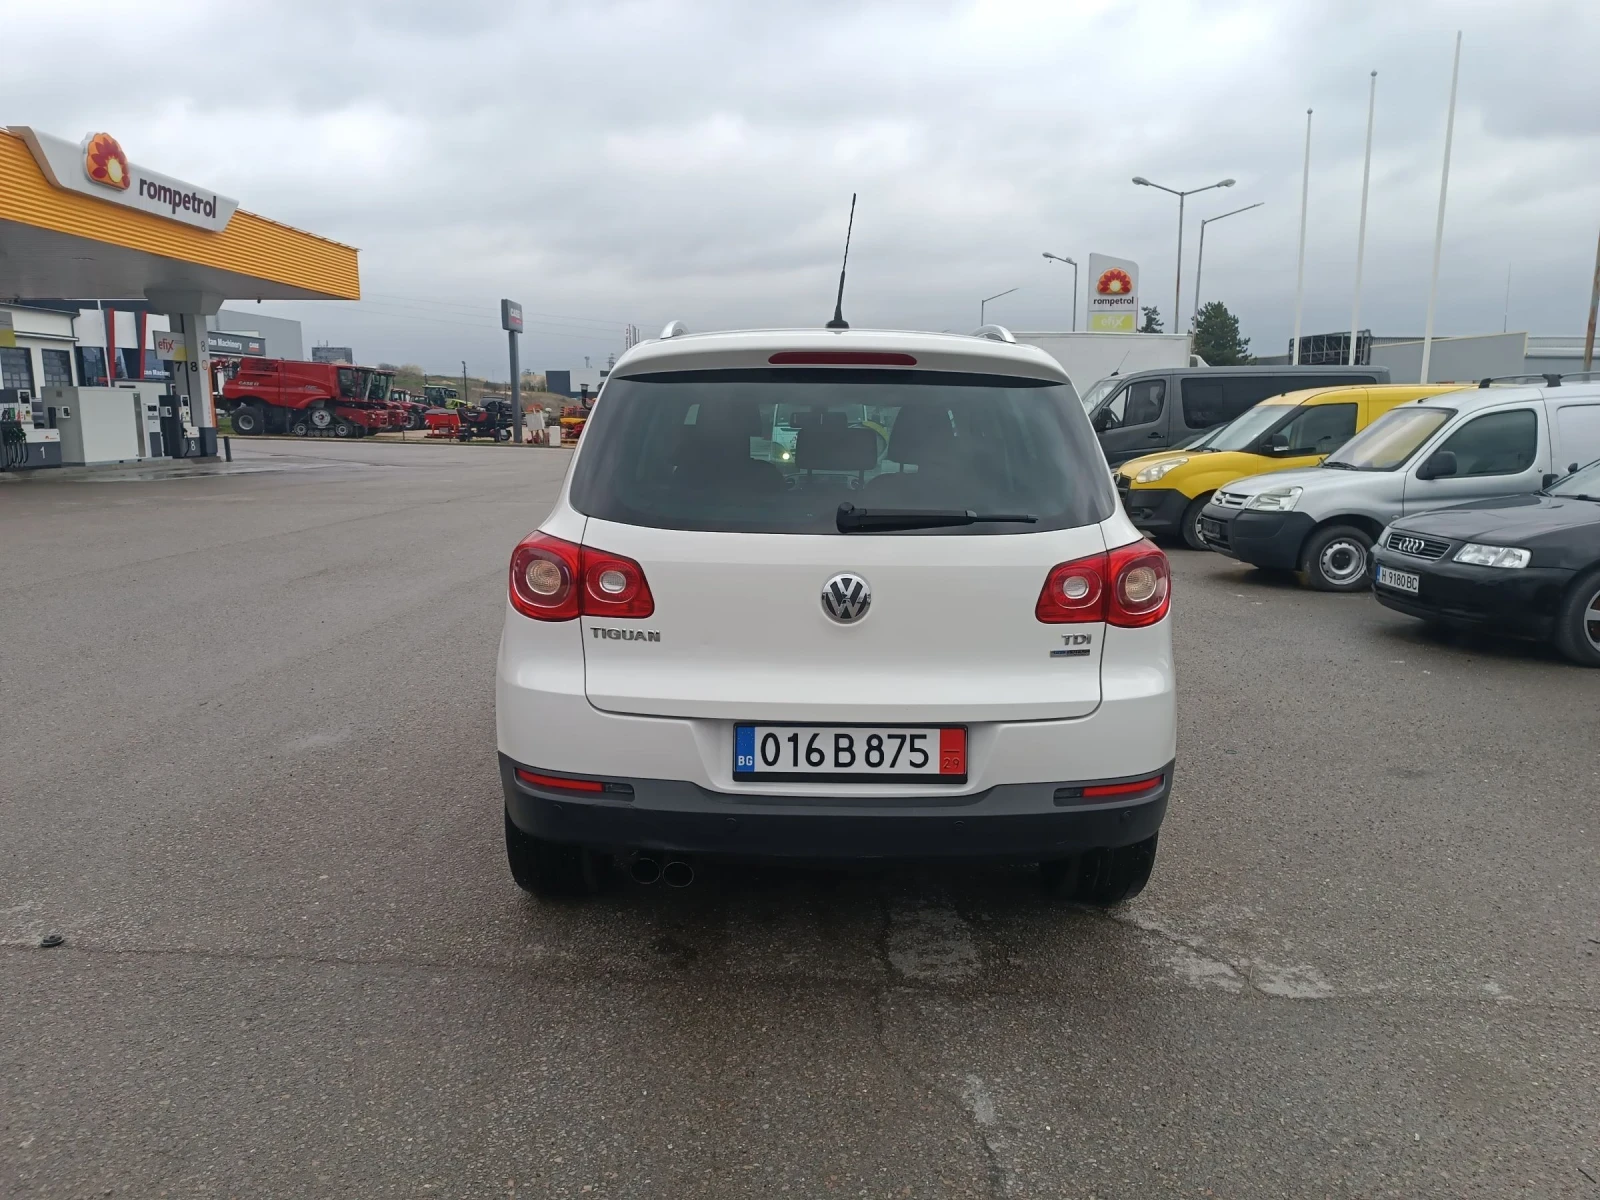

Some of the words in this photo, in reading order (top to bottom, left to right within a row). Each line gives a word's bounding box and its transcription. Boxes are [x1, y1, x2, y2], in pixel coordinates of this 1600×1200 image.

[139, 178, 217, 219] rompetrol
[1093, 296, 1134, 306] rompetrol
[1101, 316, 1124, 328] efix
[158, 338, 175, 353] efix
[217, 338, 242, 350] Machinery
[175, 361, 182, 372] 7
[190, 361, 198, 372] 8
[190, 440, 196, 451] 8
[40, 446, 46, 459] 1
[590, 627, 661, 642] TIGUAN
[1061, 633, 1092, 646] TDI
[738, 755, 753, 766] BG
[943, 757, 960, 769] 29
